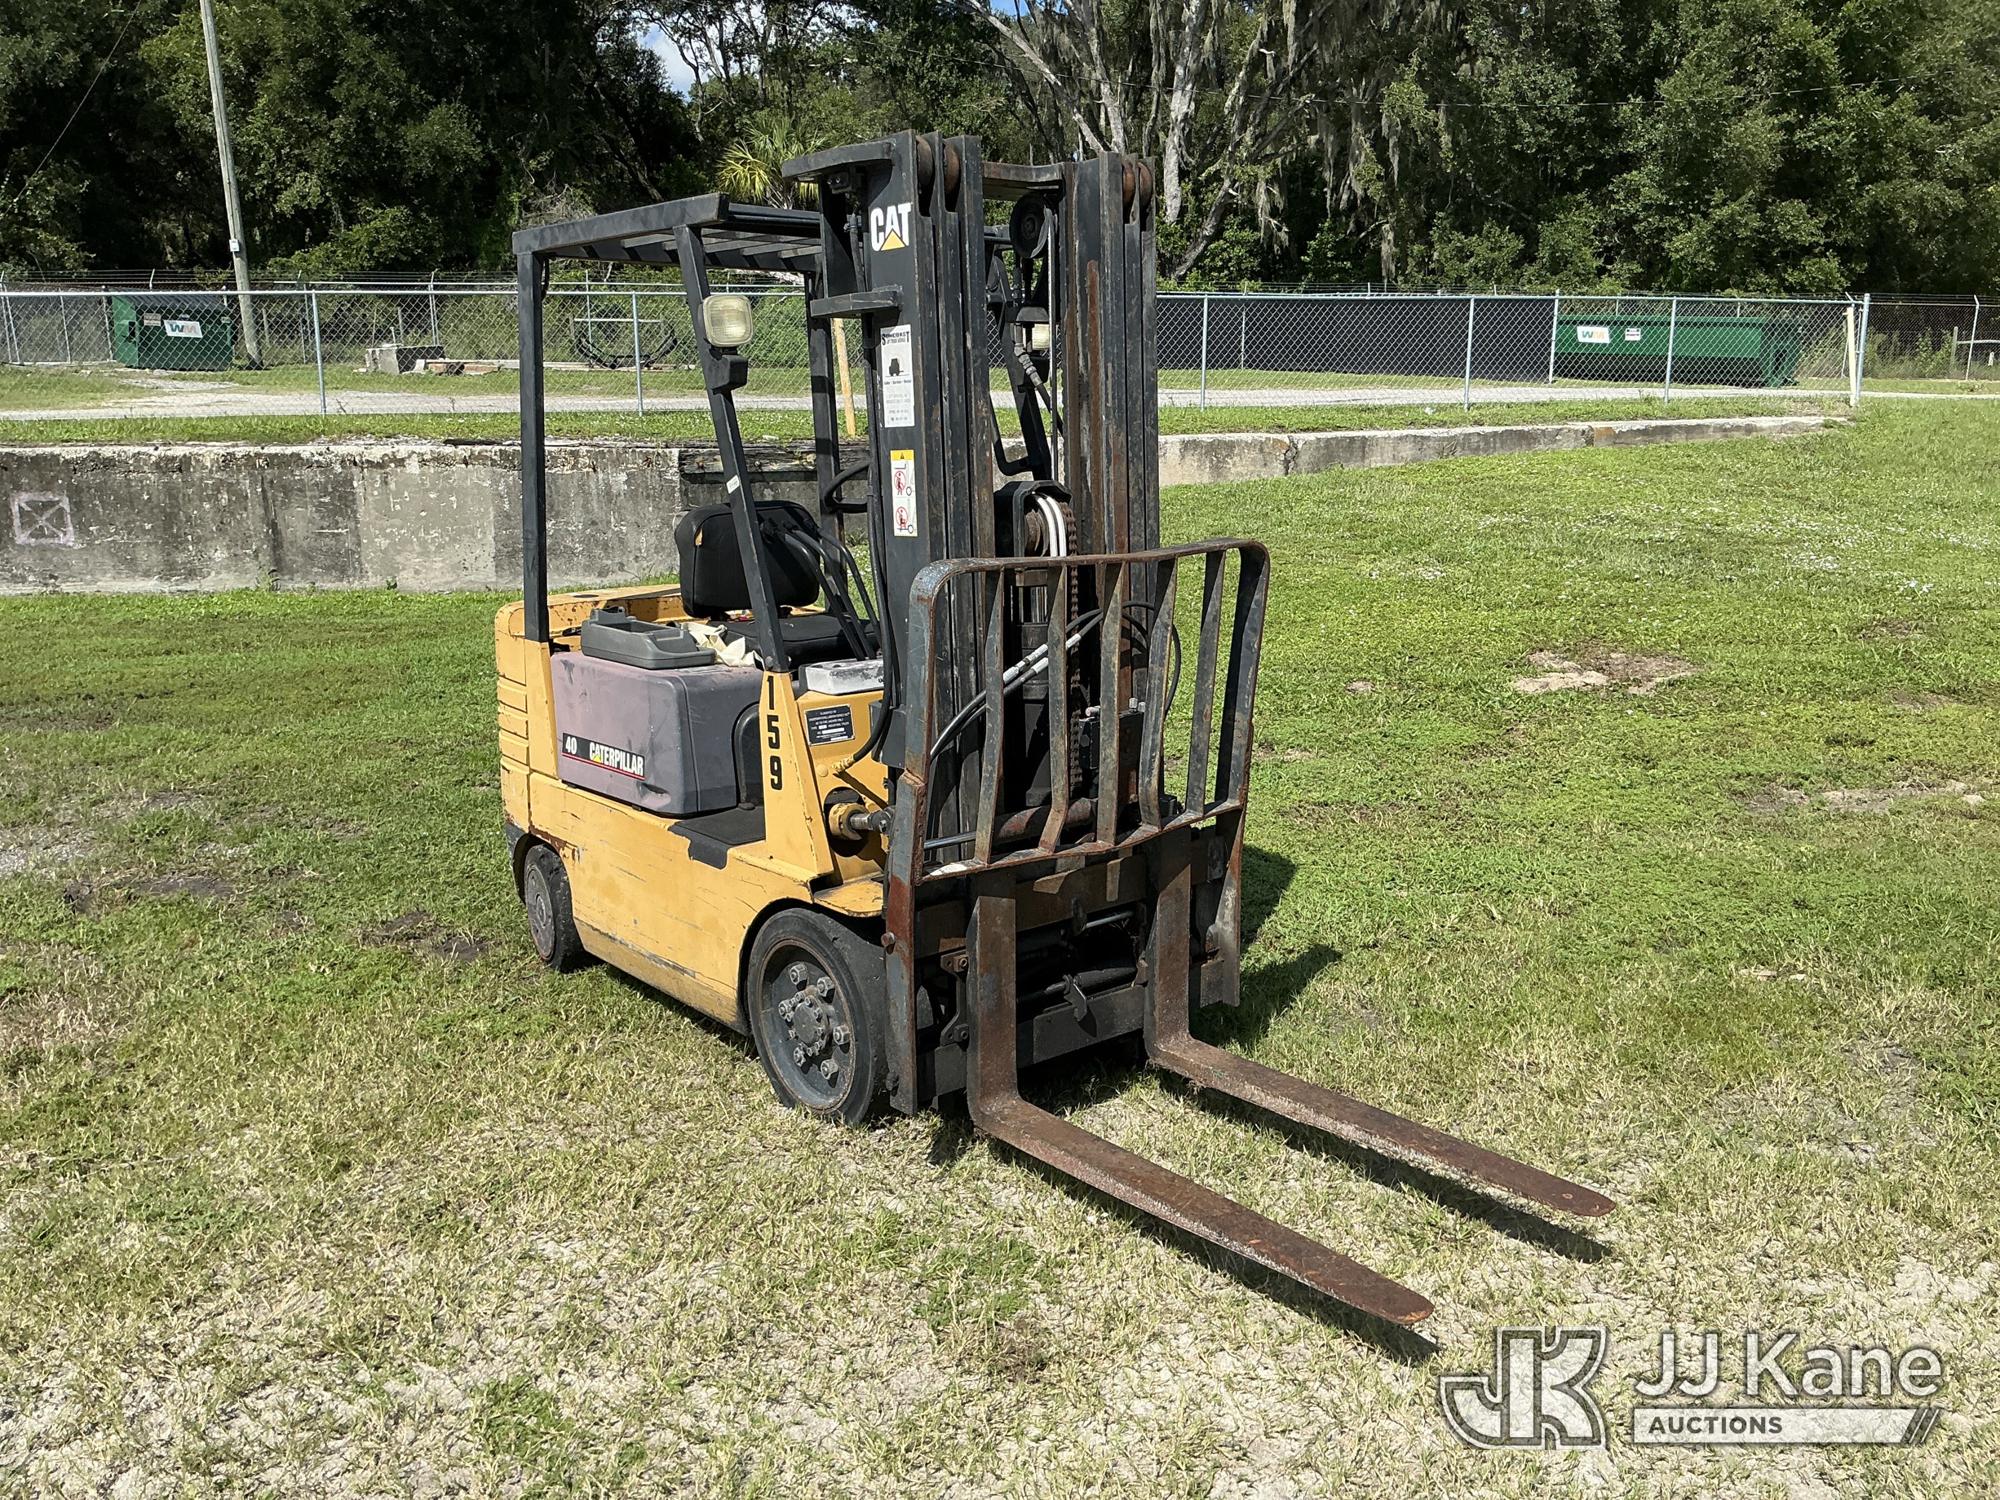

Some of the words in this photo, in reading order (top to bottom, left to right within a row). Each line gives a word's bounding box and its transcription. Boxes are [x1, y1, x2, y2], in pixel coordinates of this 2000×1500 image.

[871, 202, 911, 251] CAT
[169, 323, 198, 334] WM
[565, 736, 578, 755] 40
[589, 742, 644, 777] CATERPILLAR
